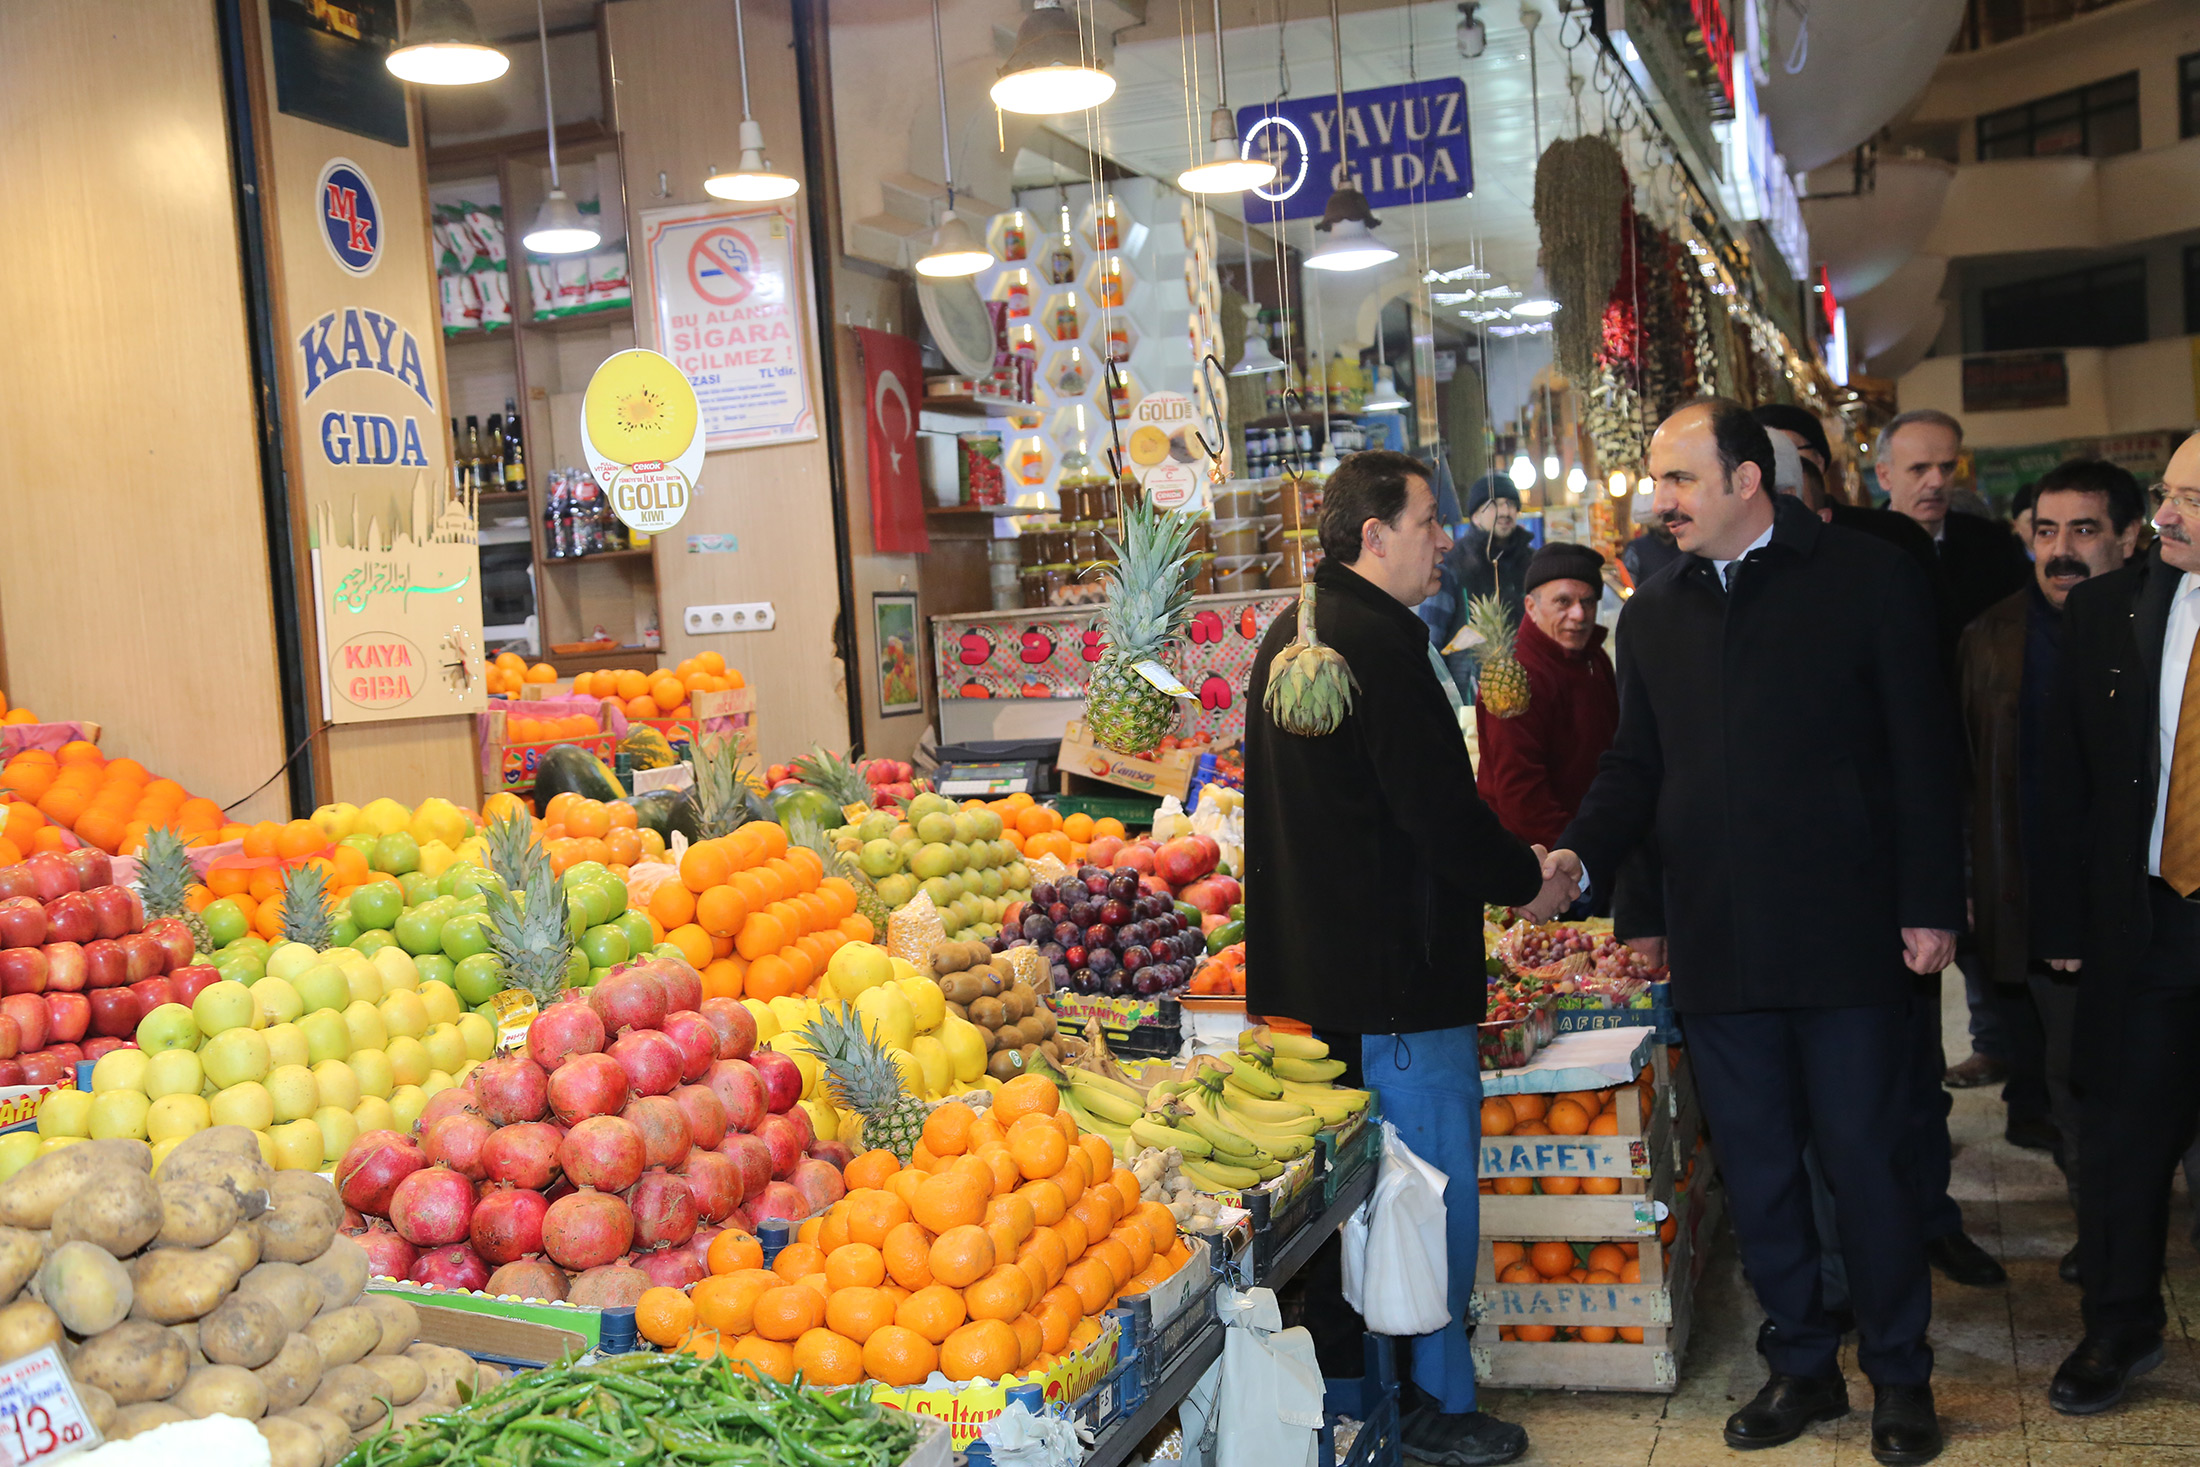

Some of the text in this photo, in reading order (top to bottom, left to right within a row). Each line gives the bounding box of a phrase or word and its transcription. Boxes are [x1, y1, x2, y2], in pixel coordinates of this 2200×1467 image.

[1310, 92, 1462, 153] YAVUZ
[1331, 148, 1459, 193] GIDA
[672, 303, 789, 329] BU ALANDA
[673, 321, 791, 352] SİGARA
[298, 307, 435, 411] KAYA
[1139, 402, 1184, 421] GOLD
[321, 411, 428, 467] GIDA
[602, 471, 611, 481] C
[618, 482, 684, 511] GOLD
[640, 510, 664, 523] KIWI
[344, 644, 412, 669] KAYA
[350, 675, 413, 701] GIDA
[1056, 1004, 1129, 1027] SULTANİYE
[1481, 1144, 1602, 1173] RAFET
[1501, 1286, 1625, 1315] RAFET
